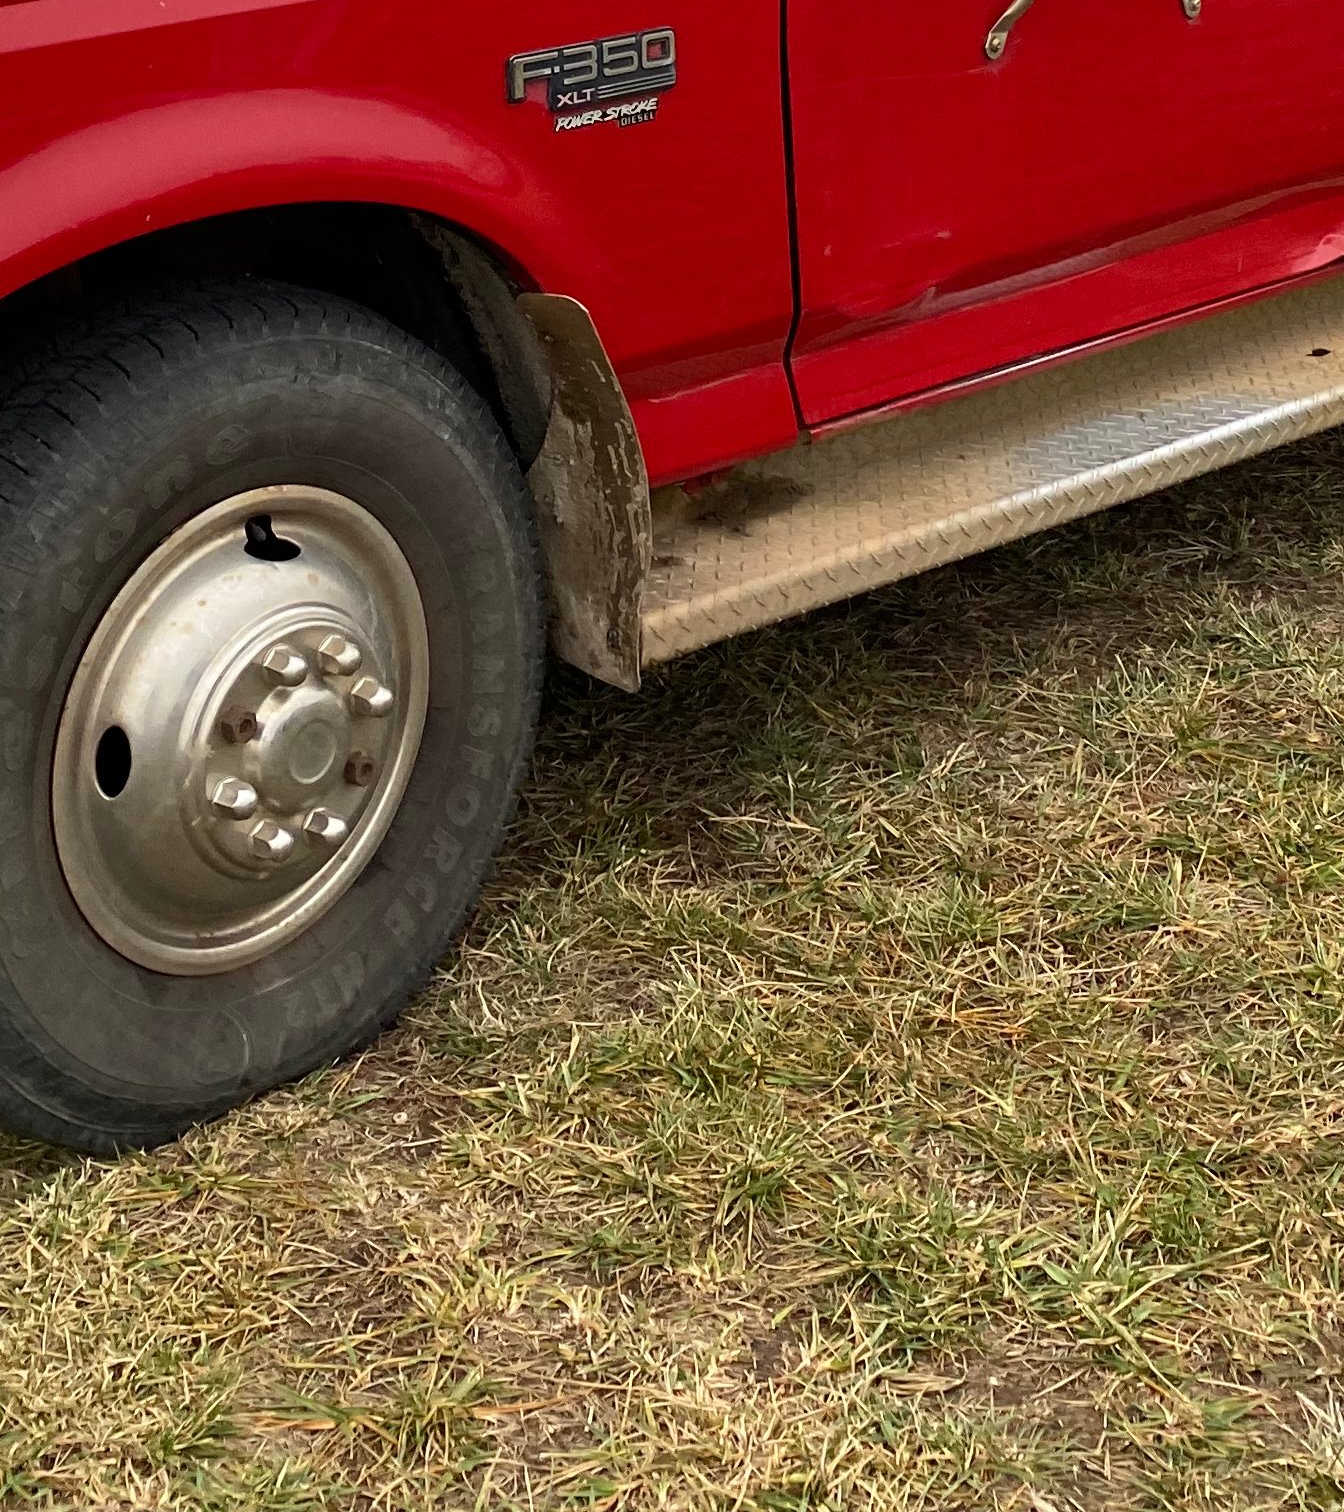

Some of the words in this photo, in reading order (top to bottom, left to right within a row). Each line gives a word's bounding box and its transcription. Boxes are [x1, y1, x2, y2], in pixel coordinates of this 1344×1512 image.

[557, 88, 595, 107] XLT
[556, 110, 603, 132] POWER
[604, 98, 658, 121] STROKE
[621, 107, 654, 126] DIESEL
